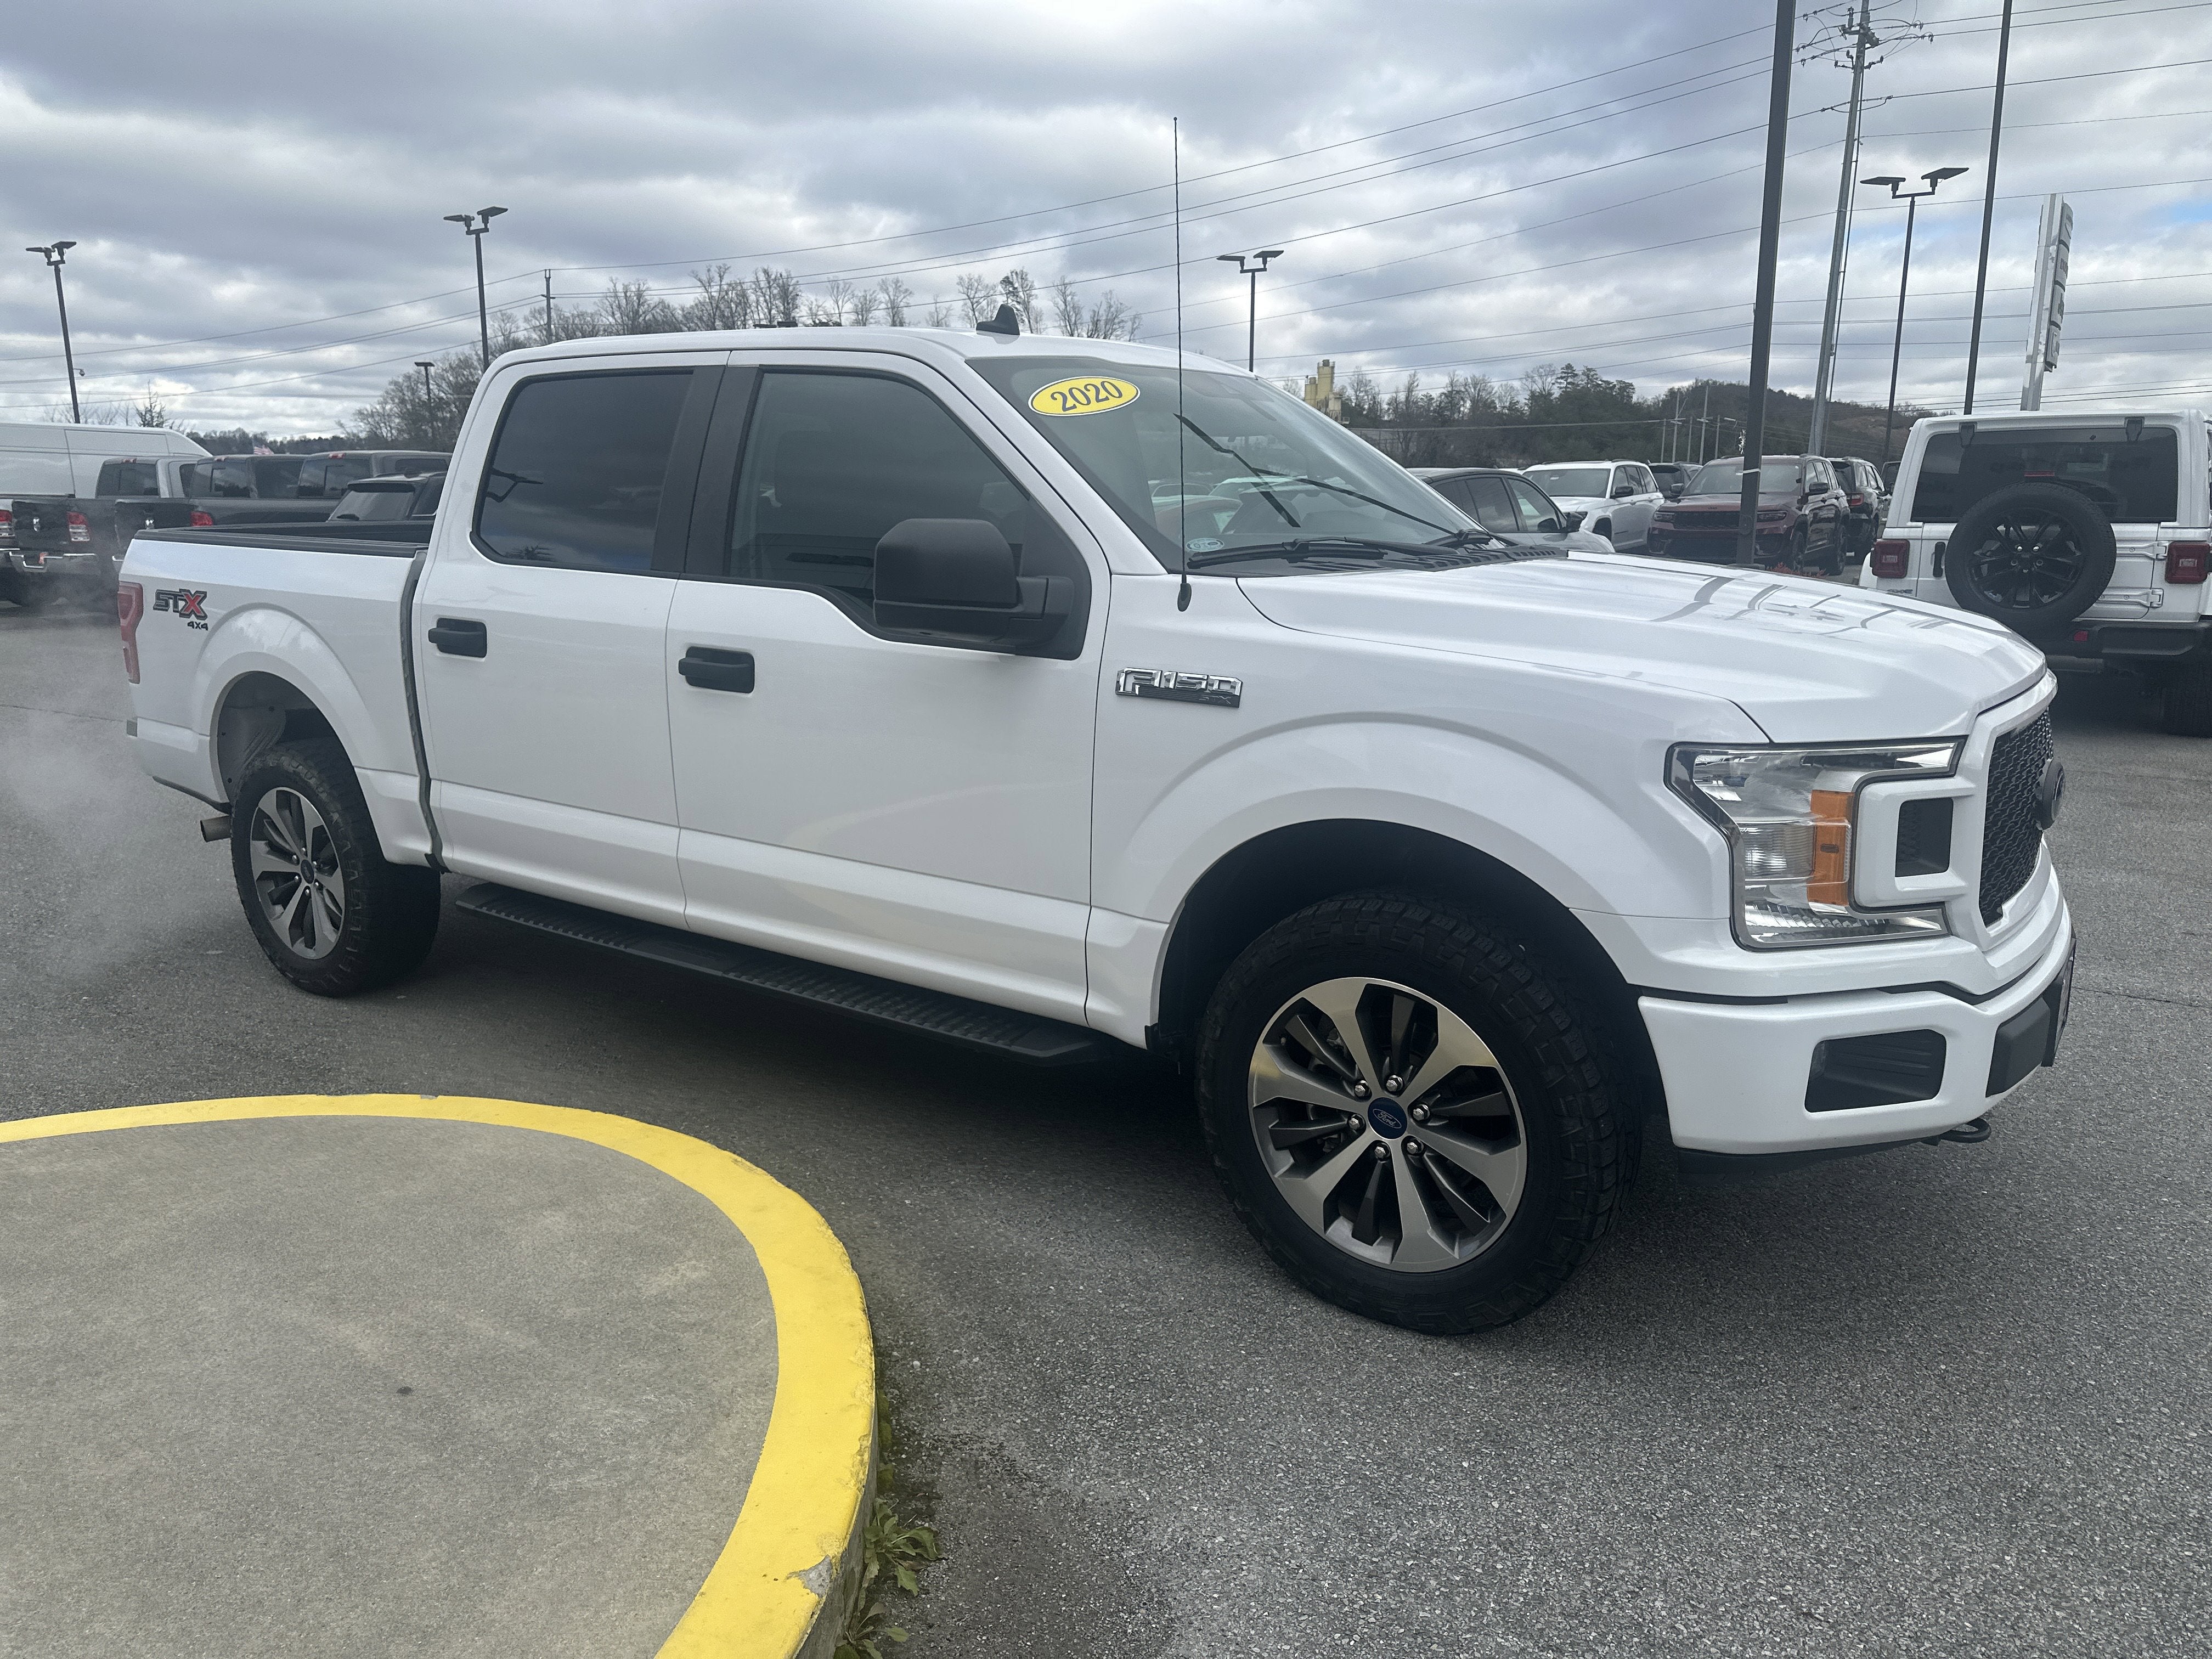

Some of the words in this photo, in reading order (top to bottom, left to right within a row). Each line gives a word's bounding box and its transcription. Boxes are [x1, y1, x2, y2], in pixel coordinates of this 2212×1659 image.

[1050, 380, 1123, 412] 2020
[153, 588, 208, 620] STX
[1377, 1111, 1397, 1126] Ford
